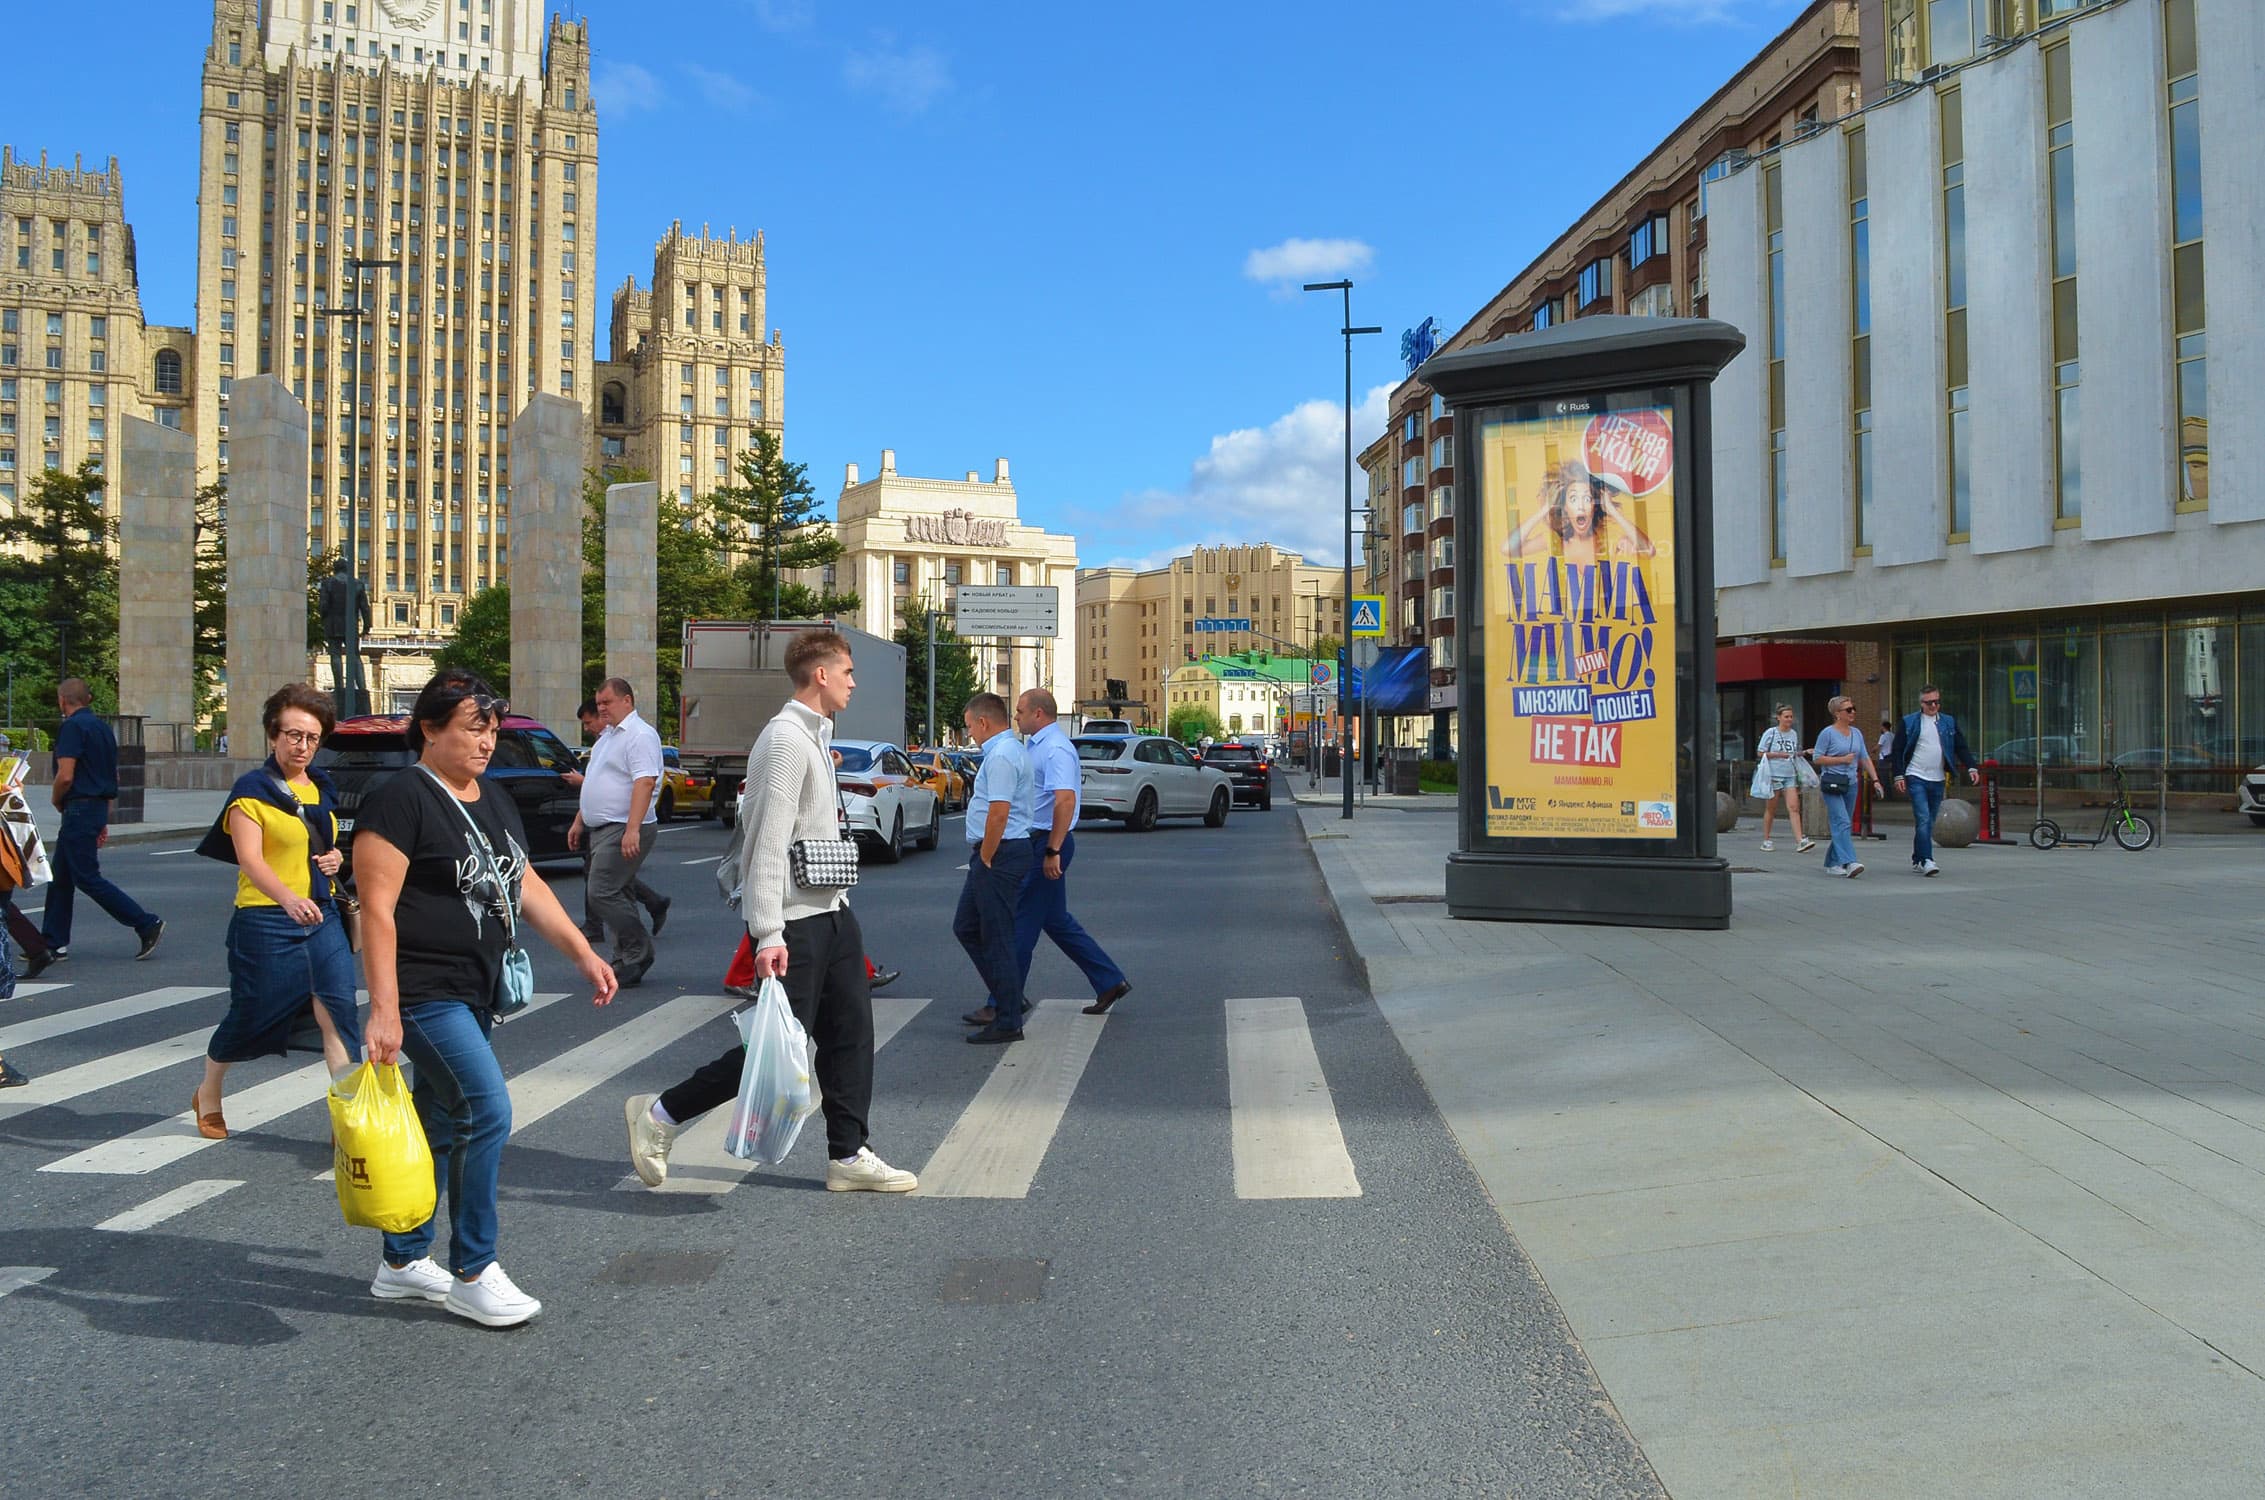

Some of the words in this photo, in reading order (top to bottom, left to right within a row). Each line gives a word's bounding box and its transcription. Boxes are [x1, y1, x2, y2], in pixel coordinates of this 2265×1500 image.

[1569, 403, 1590, 412] Russ
[1600, 415, 1669, 459] ЛЕТНЯЯ
[1589, 433, 1660, 481] АКЦИЯ
[1504, 556, 1658, 626] МАММА
[1576, 651, 1606, 675] ИЛИ
[1519, 688, 1588, 714] МЮЗИКЛ
[1596, 692, 1652, 722] ПОШЁЛ
[1534, 723, 1565, 760] НЕ
[1571, 725, 1617, 763] ТАК
[1558, 800, 1585, 808] Яндекс
[1586, 801, 1613, 809] Афиша
